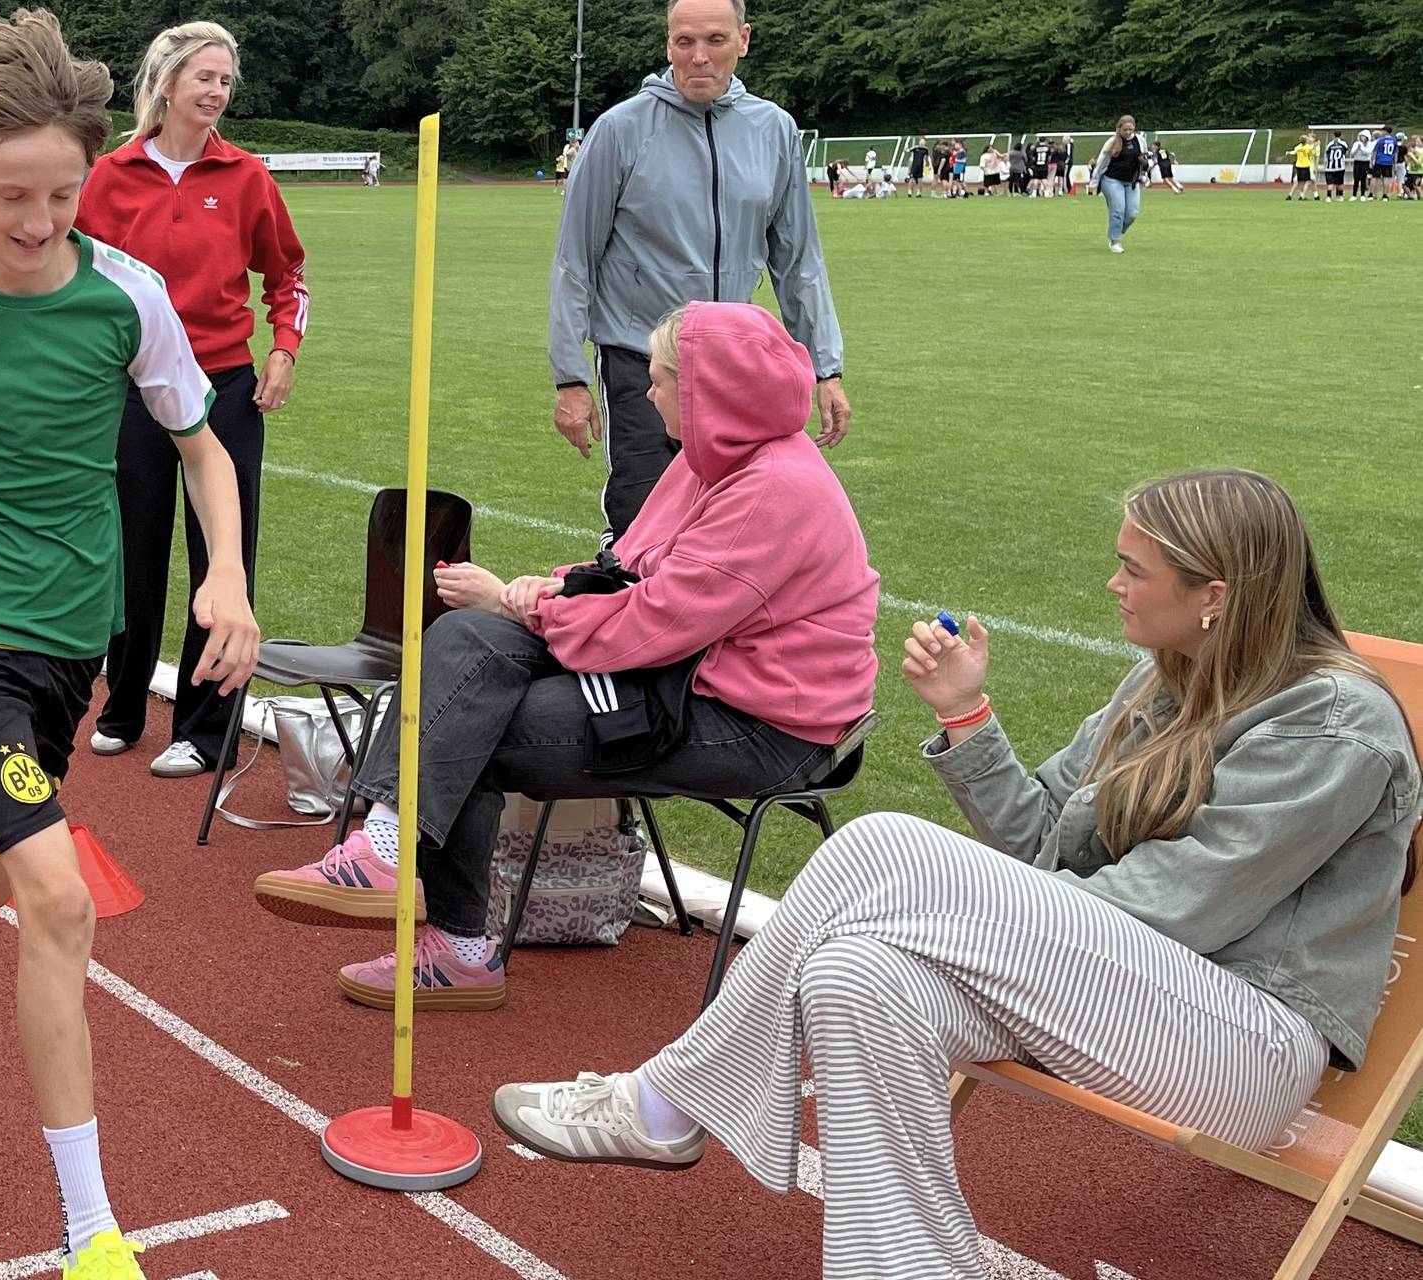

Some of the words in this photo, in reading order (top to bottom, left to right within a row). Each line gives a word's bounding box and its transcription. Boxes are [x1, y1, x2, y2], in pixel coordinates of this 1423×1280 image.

[1329, 149, 1343, 160] 10
[1384, 143, 1395, 155] 10
[8, 758, 46, 793] BVB
[27, 785, 43, 798] 09
